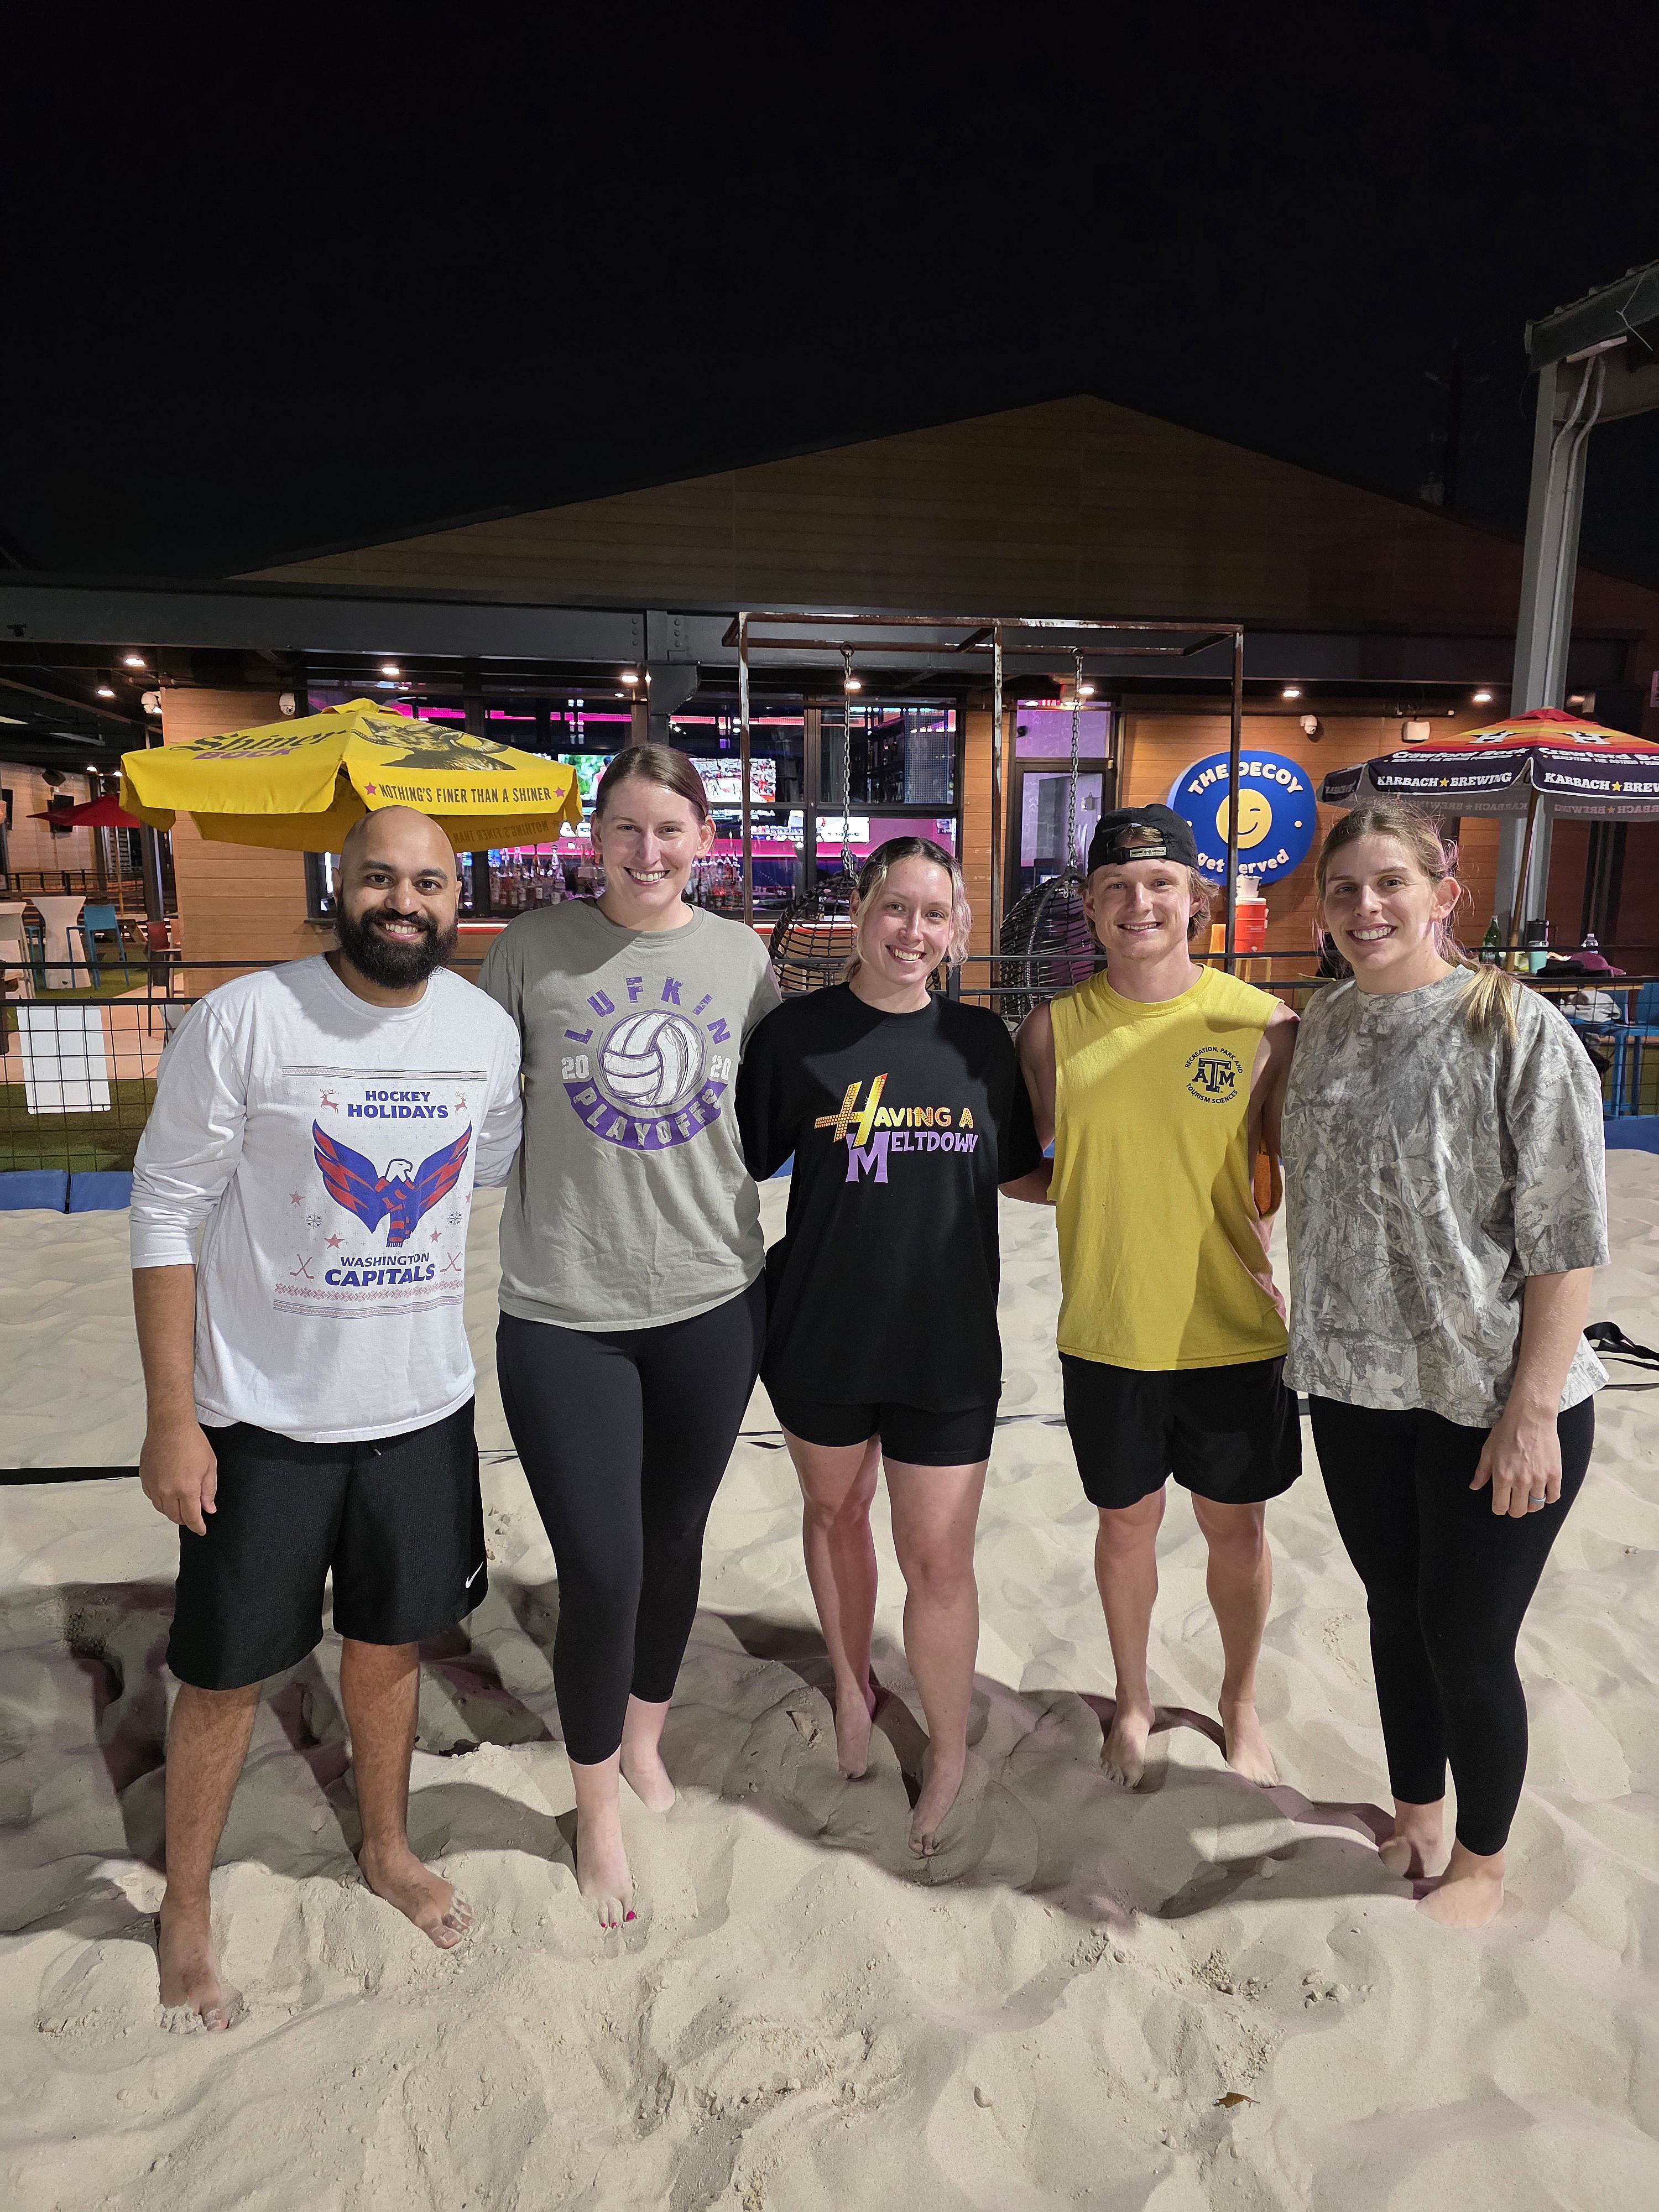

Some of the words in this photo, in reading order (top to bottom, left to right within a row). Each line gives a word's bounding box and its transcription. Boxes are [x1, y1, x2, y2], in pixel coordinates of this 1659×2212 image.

[169, 729, 346, 752] Shiner
[191, 747, 303, 760] BOCK
[1479, 748, 1531, 757] Bock
[1538, 747, 1632, 760] Crawford
[1188, 763, 1229, 795] THE
[1377, 776, 1439, 787] KARBACH
[1449, 772, 1512, 786] BREWING
[1543, 773, 1611, 791] KARBACH
[379, 784, 433, 803] NOTHING'S
[436, 787, 468, 803] FINER
[471, 788, 498, 803] THAN
[502, 788, 509, 802] A
[513, 787, 552, 802] SHINER
[1238, 848, 1290, 874] erved
[564, 976, 731, 1045] LUFKIN
[561, 1055, 590, 1079] 20
[709, 1055, 732, 1081] 20
[1220, 1048, 1236, 1060] PARK
[1234, 1061, 1243, 1073] AND
[365, 1091, 431, 1102] HOCKEY
[1186, 1083, 1211, 1103] TOURISM
[1212, 1089, 1238, 1104] SCIENCES
[347, 1104, 448, 1119] HOLIDAYS
[573, 1087, 721, 1146] PLAYOFFS
[814, 1072, 952, 1147] HAVING
[959, 1108, 974, 1129] A
[340, 1252, 429, 1267] WASHINGTON
[325, 1264, 435, 1287] CAPITALS
